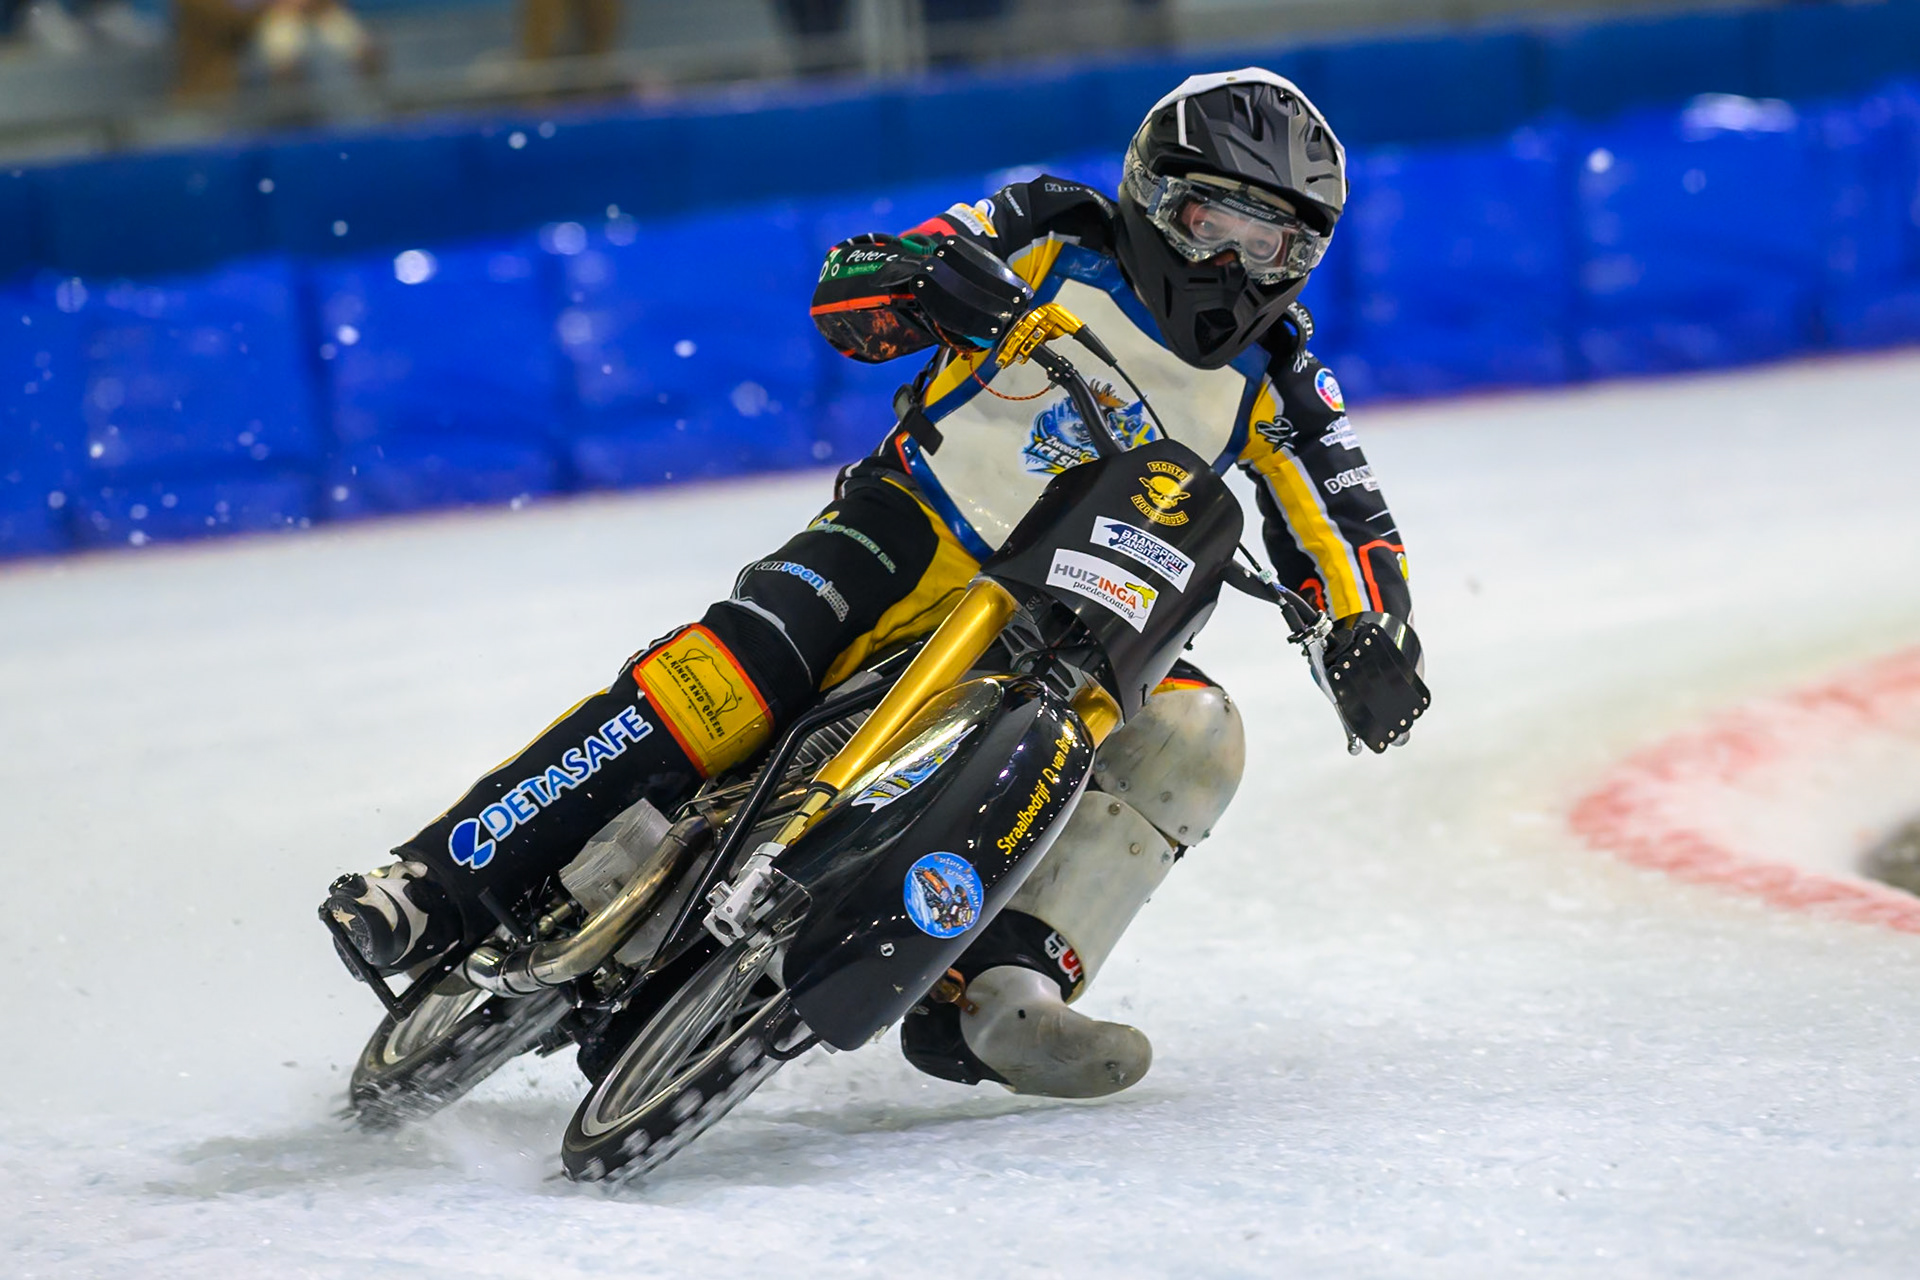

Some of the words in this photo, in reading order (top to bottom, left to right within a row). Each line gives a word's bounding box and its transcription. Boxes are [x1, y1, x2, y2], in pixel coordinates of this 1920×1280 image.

[846, 249, 887, 263] Peter
[1030, 442, 1060, 461] ICE
[1045, 435, 1080, 458] Zweeds
[1118, 537, 1169, 569] FANSITE.NL
[1120, 529, 1188, 570] BAANSPORT
[1054, 563, 1138, 610] HUIZINGA
[1072, 580, 1135, 620] poedercoating
[670, 659, 691, 683] KINGS
[688, 683, 705, 703] AND
[702, 704, 725, 738] QUEENS
[479, 705, 653, 841] DETASAFE
[997, 779, 1051, 855] Straalbedrijf
[1051, 751, 1066, 771] van
